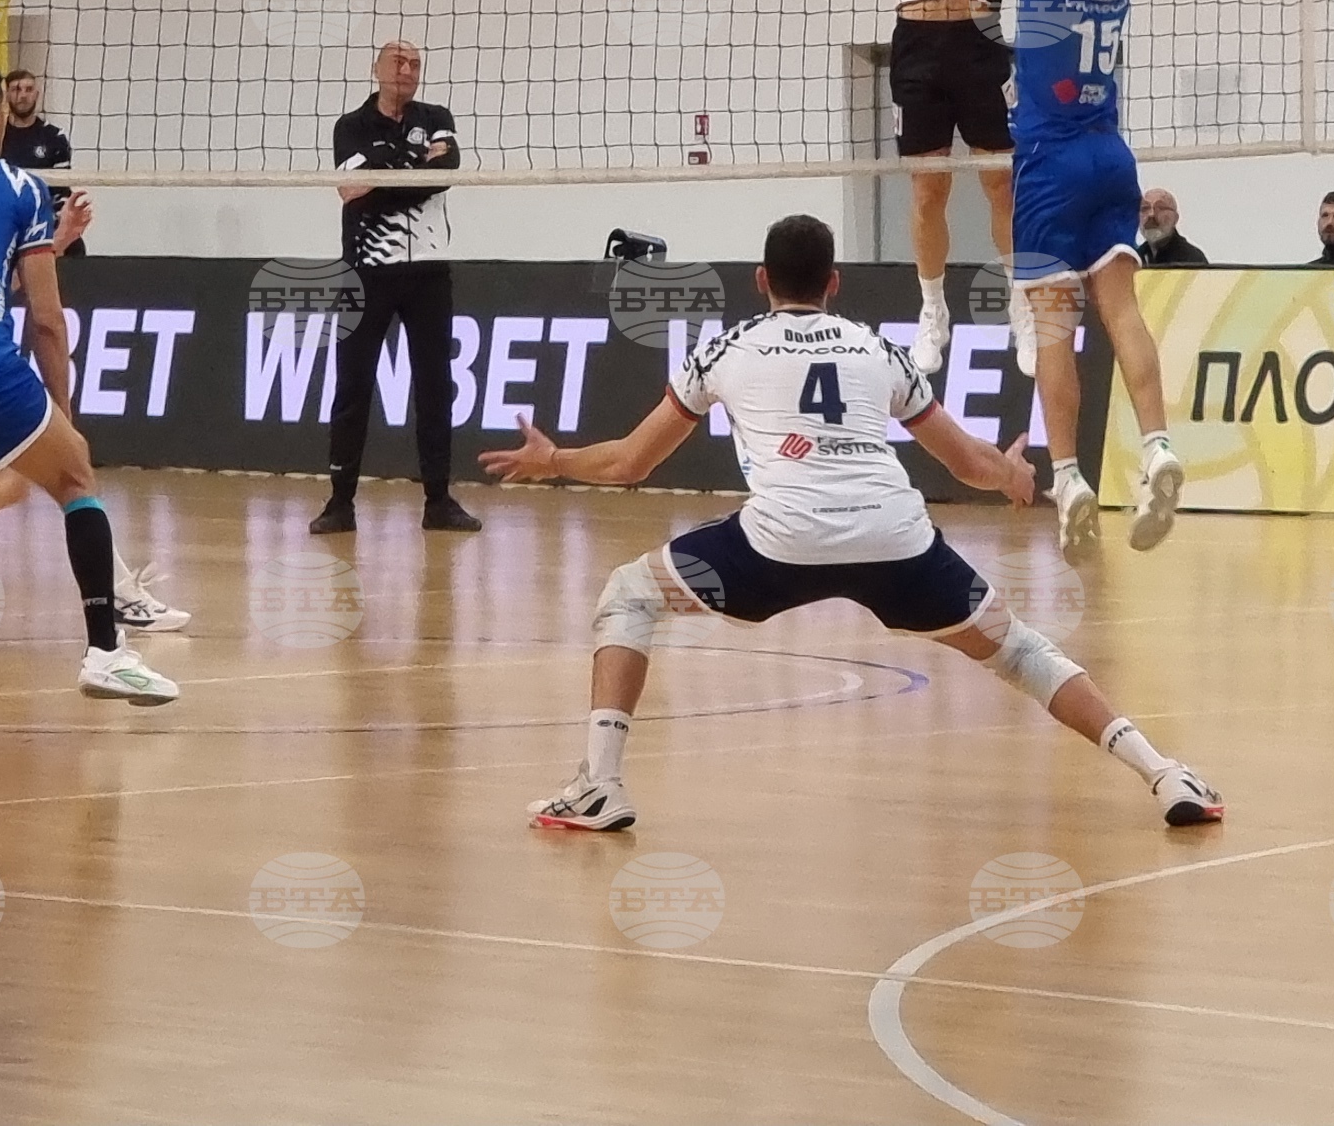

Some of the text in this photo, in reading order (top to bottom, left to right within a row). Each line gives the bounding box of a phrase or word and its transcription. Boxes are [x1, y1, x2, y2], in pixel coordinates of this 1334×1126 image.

[1070, 20, 1121, 75] 15
[758, 345, 870, 355] VIVACOM
[799, 362, 847, 425] 4
